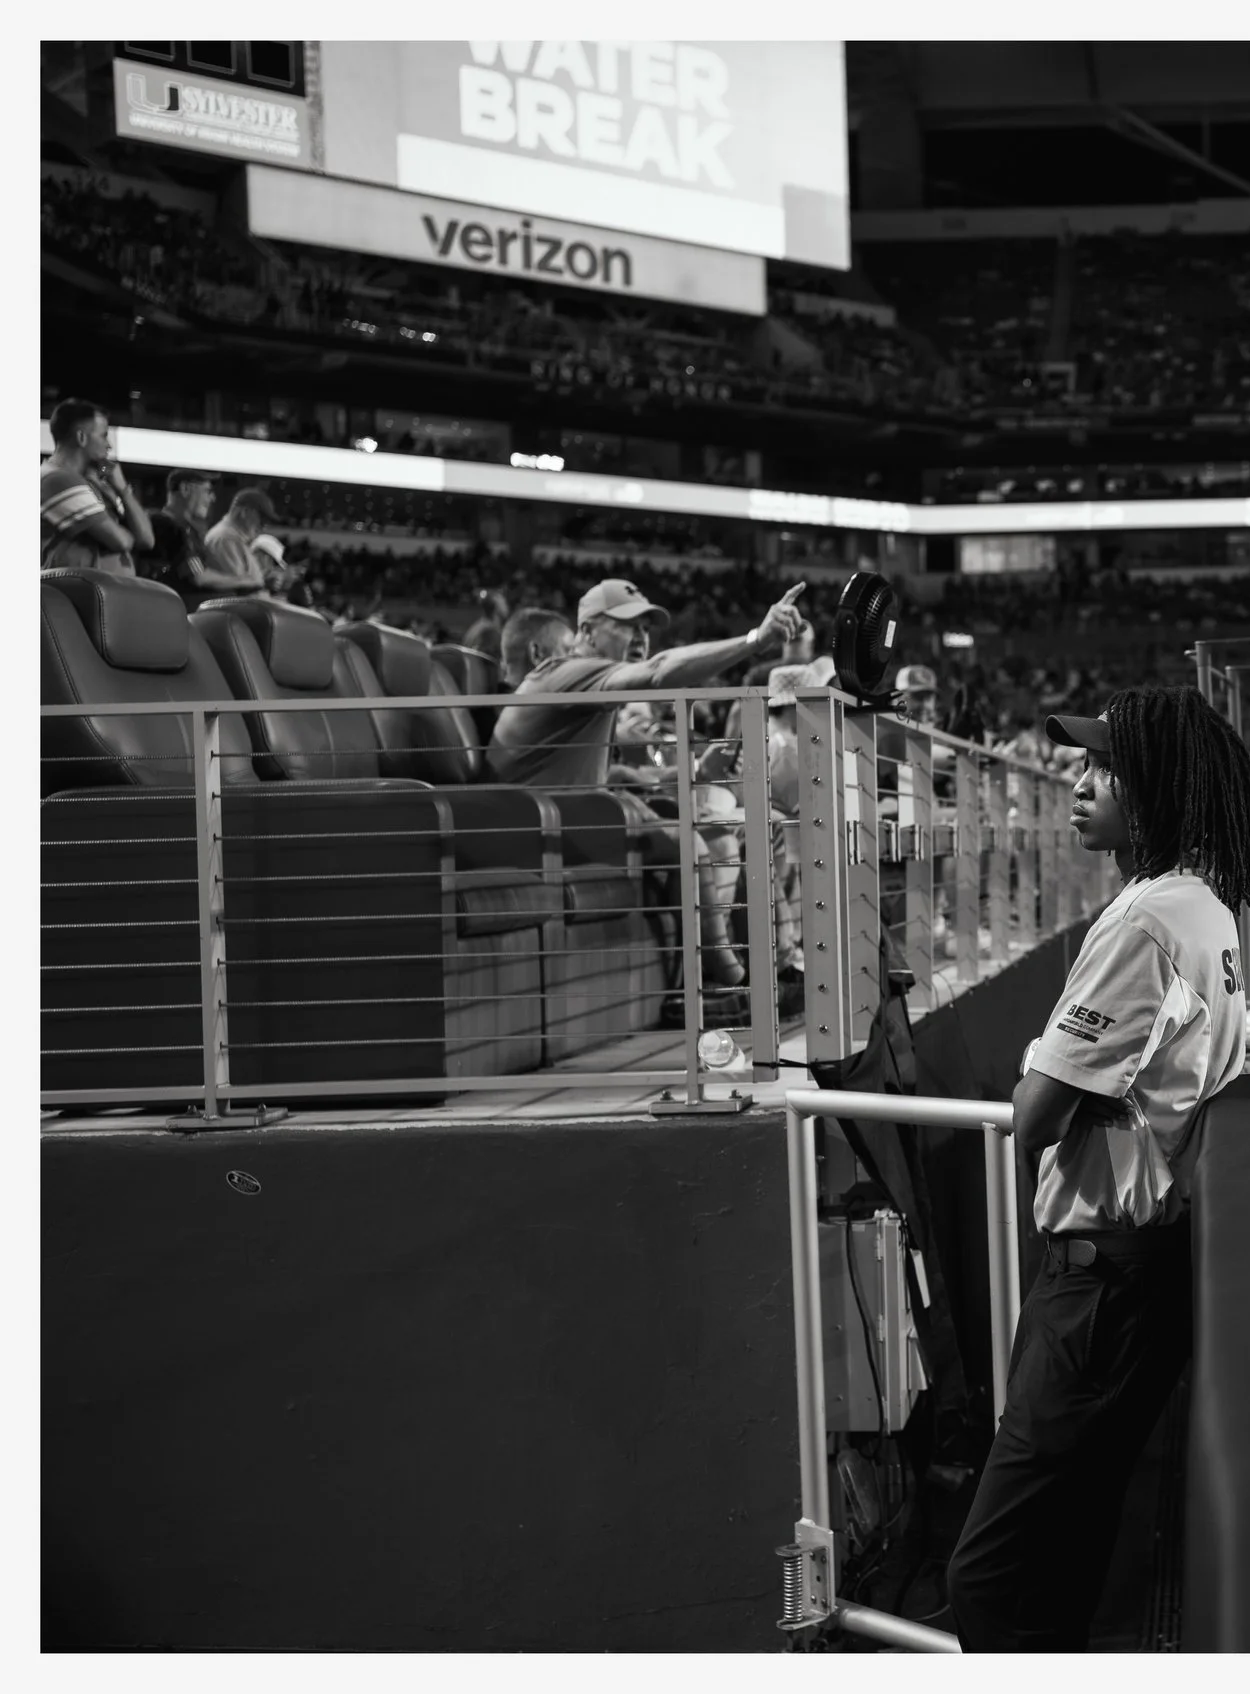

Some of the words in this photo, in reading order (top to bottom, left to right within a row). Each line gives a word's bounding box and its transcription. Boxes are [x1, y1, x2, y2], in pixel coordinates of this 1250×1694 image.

[183, 86, 298, 130] SYLVESTER
[460, 64, 736, 189] BREAK
[423, 214, 634, 287] verizon
[531, 359, 592, 385] RING
[650, 377, 733, 399] HONOR
[1067, 1004, 1116, 1030] BEST
